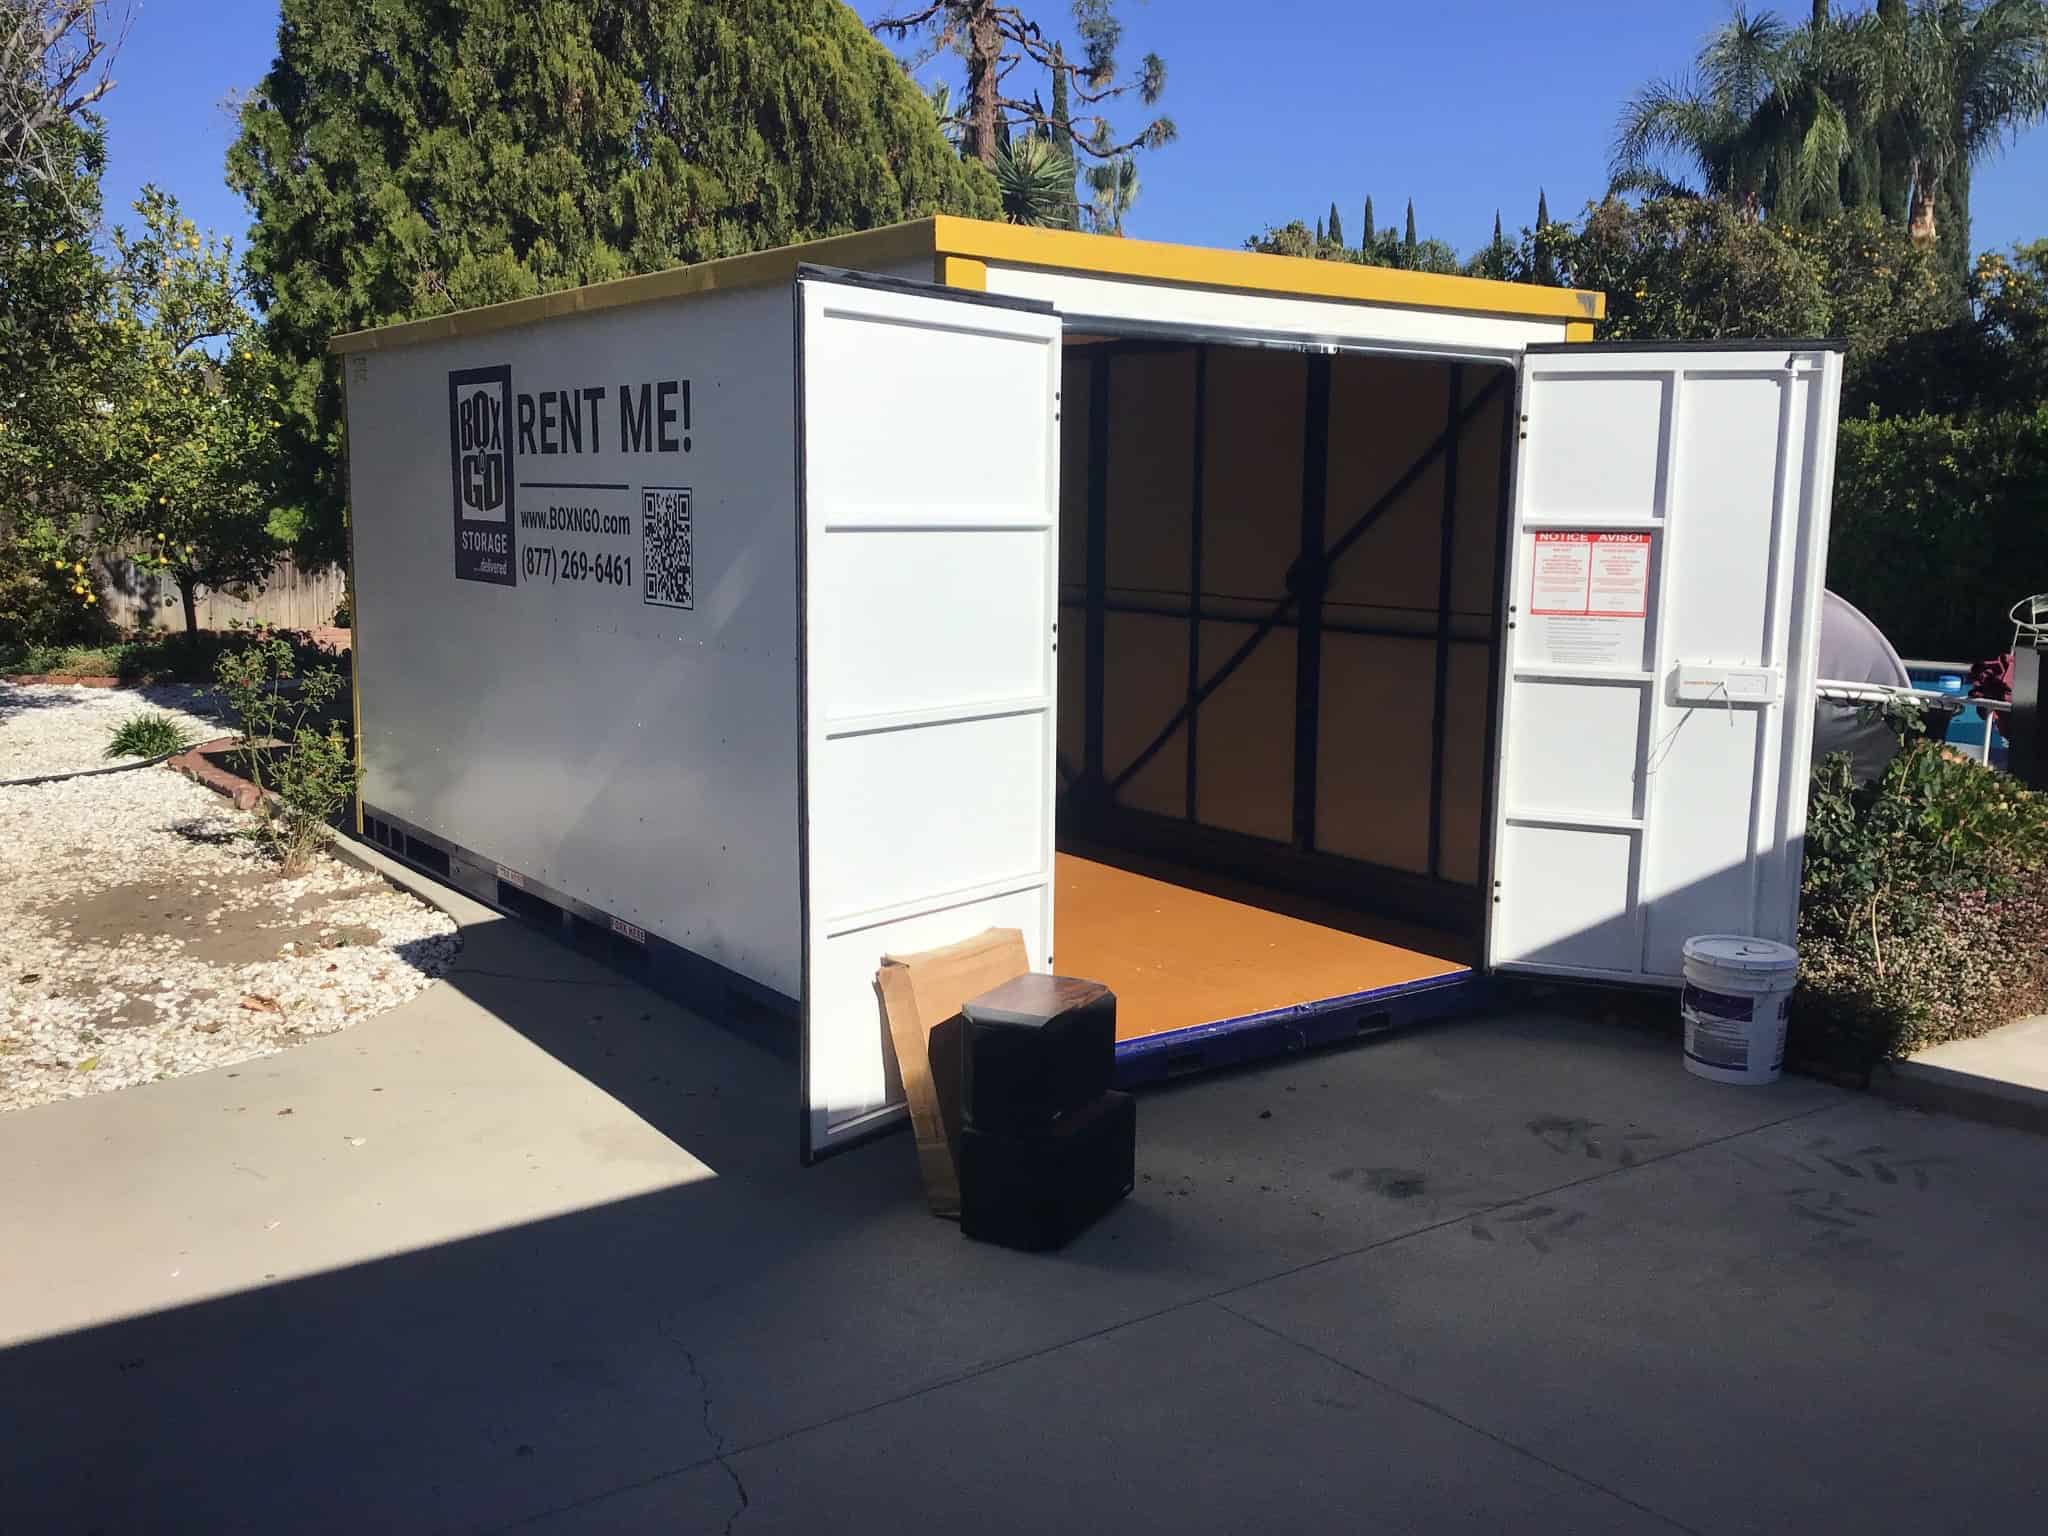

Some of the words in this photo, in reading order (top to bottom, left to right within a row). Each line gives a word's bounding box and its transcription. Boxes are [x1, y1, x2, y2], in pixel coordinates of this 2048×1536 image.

[460, 391, 503, 451] BOX
[517, 387, 606, 455] RENT
[619, 380, 692, 453] ME!
[520, 507, 631, 536] www.BOXNGO.com
[1540, 532, 1589, 541] NOTICE
[462, 531, 508, 554] STORAGE
[522, 545, 558, 584] (877)
[561, 550, 632, 587] 269-6461
